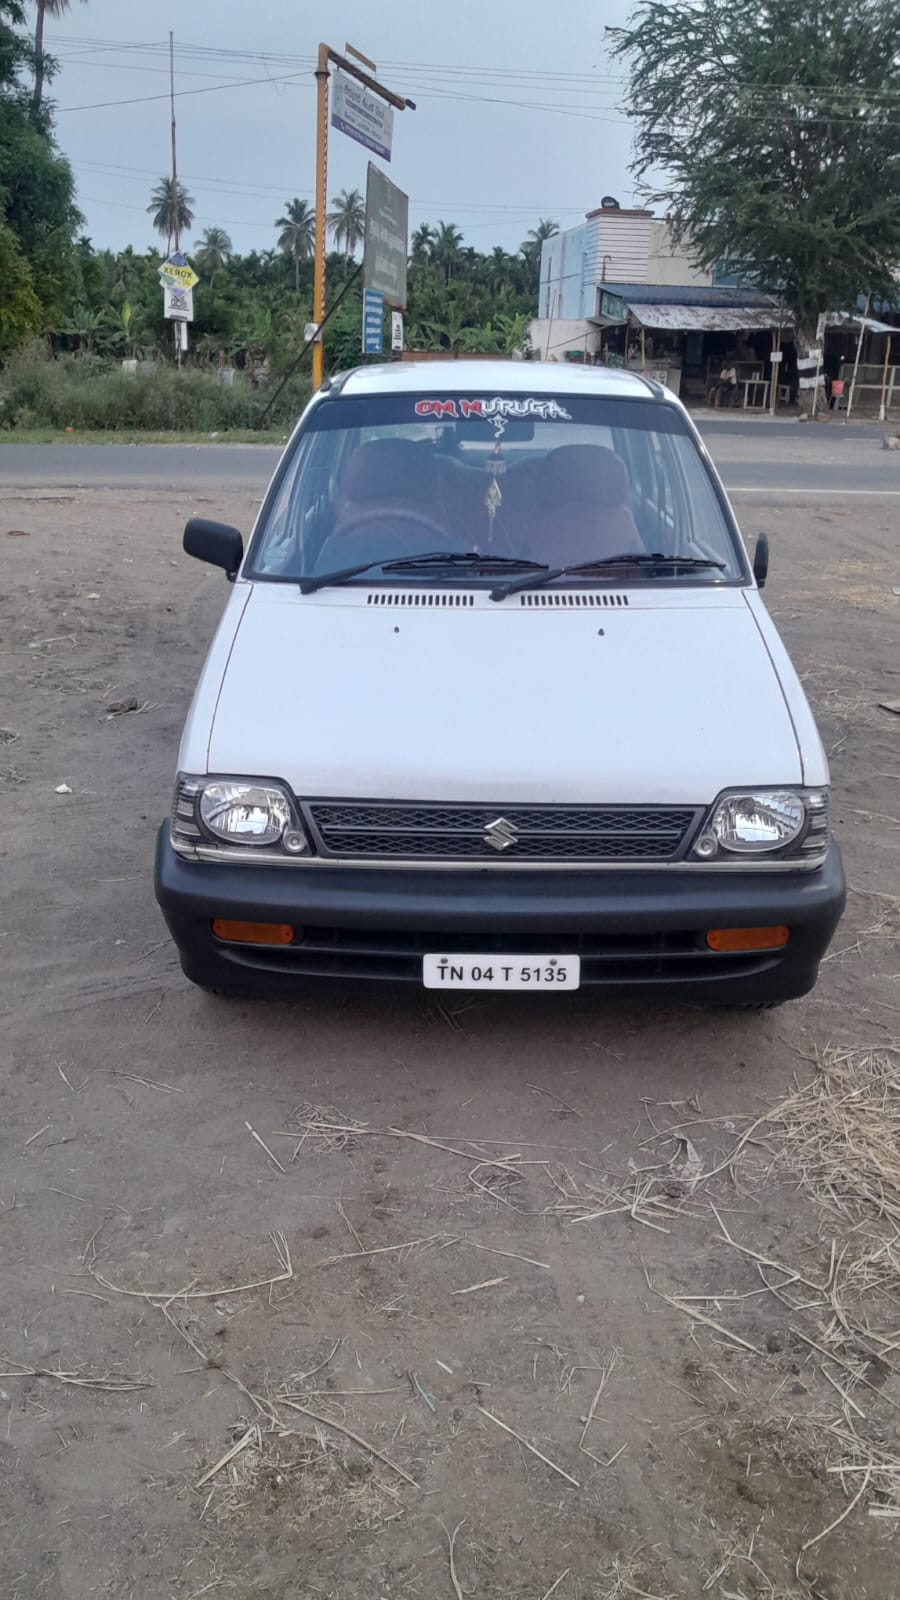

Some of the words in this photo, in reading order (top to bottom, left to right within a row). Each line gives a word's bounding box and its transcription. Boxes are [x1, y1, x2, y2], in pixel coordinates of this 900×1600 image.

[163, 266, 193, 279] XEROX
[414, 398, 459, 419] OM
[459, 396, 573, 420] MURUGA
[436, 966, 464, 981] TN
[471, 966, 494, 982] 04
[501, 967, 514, 982] T
[520, 967, 567, 982] 5135
